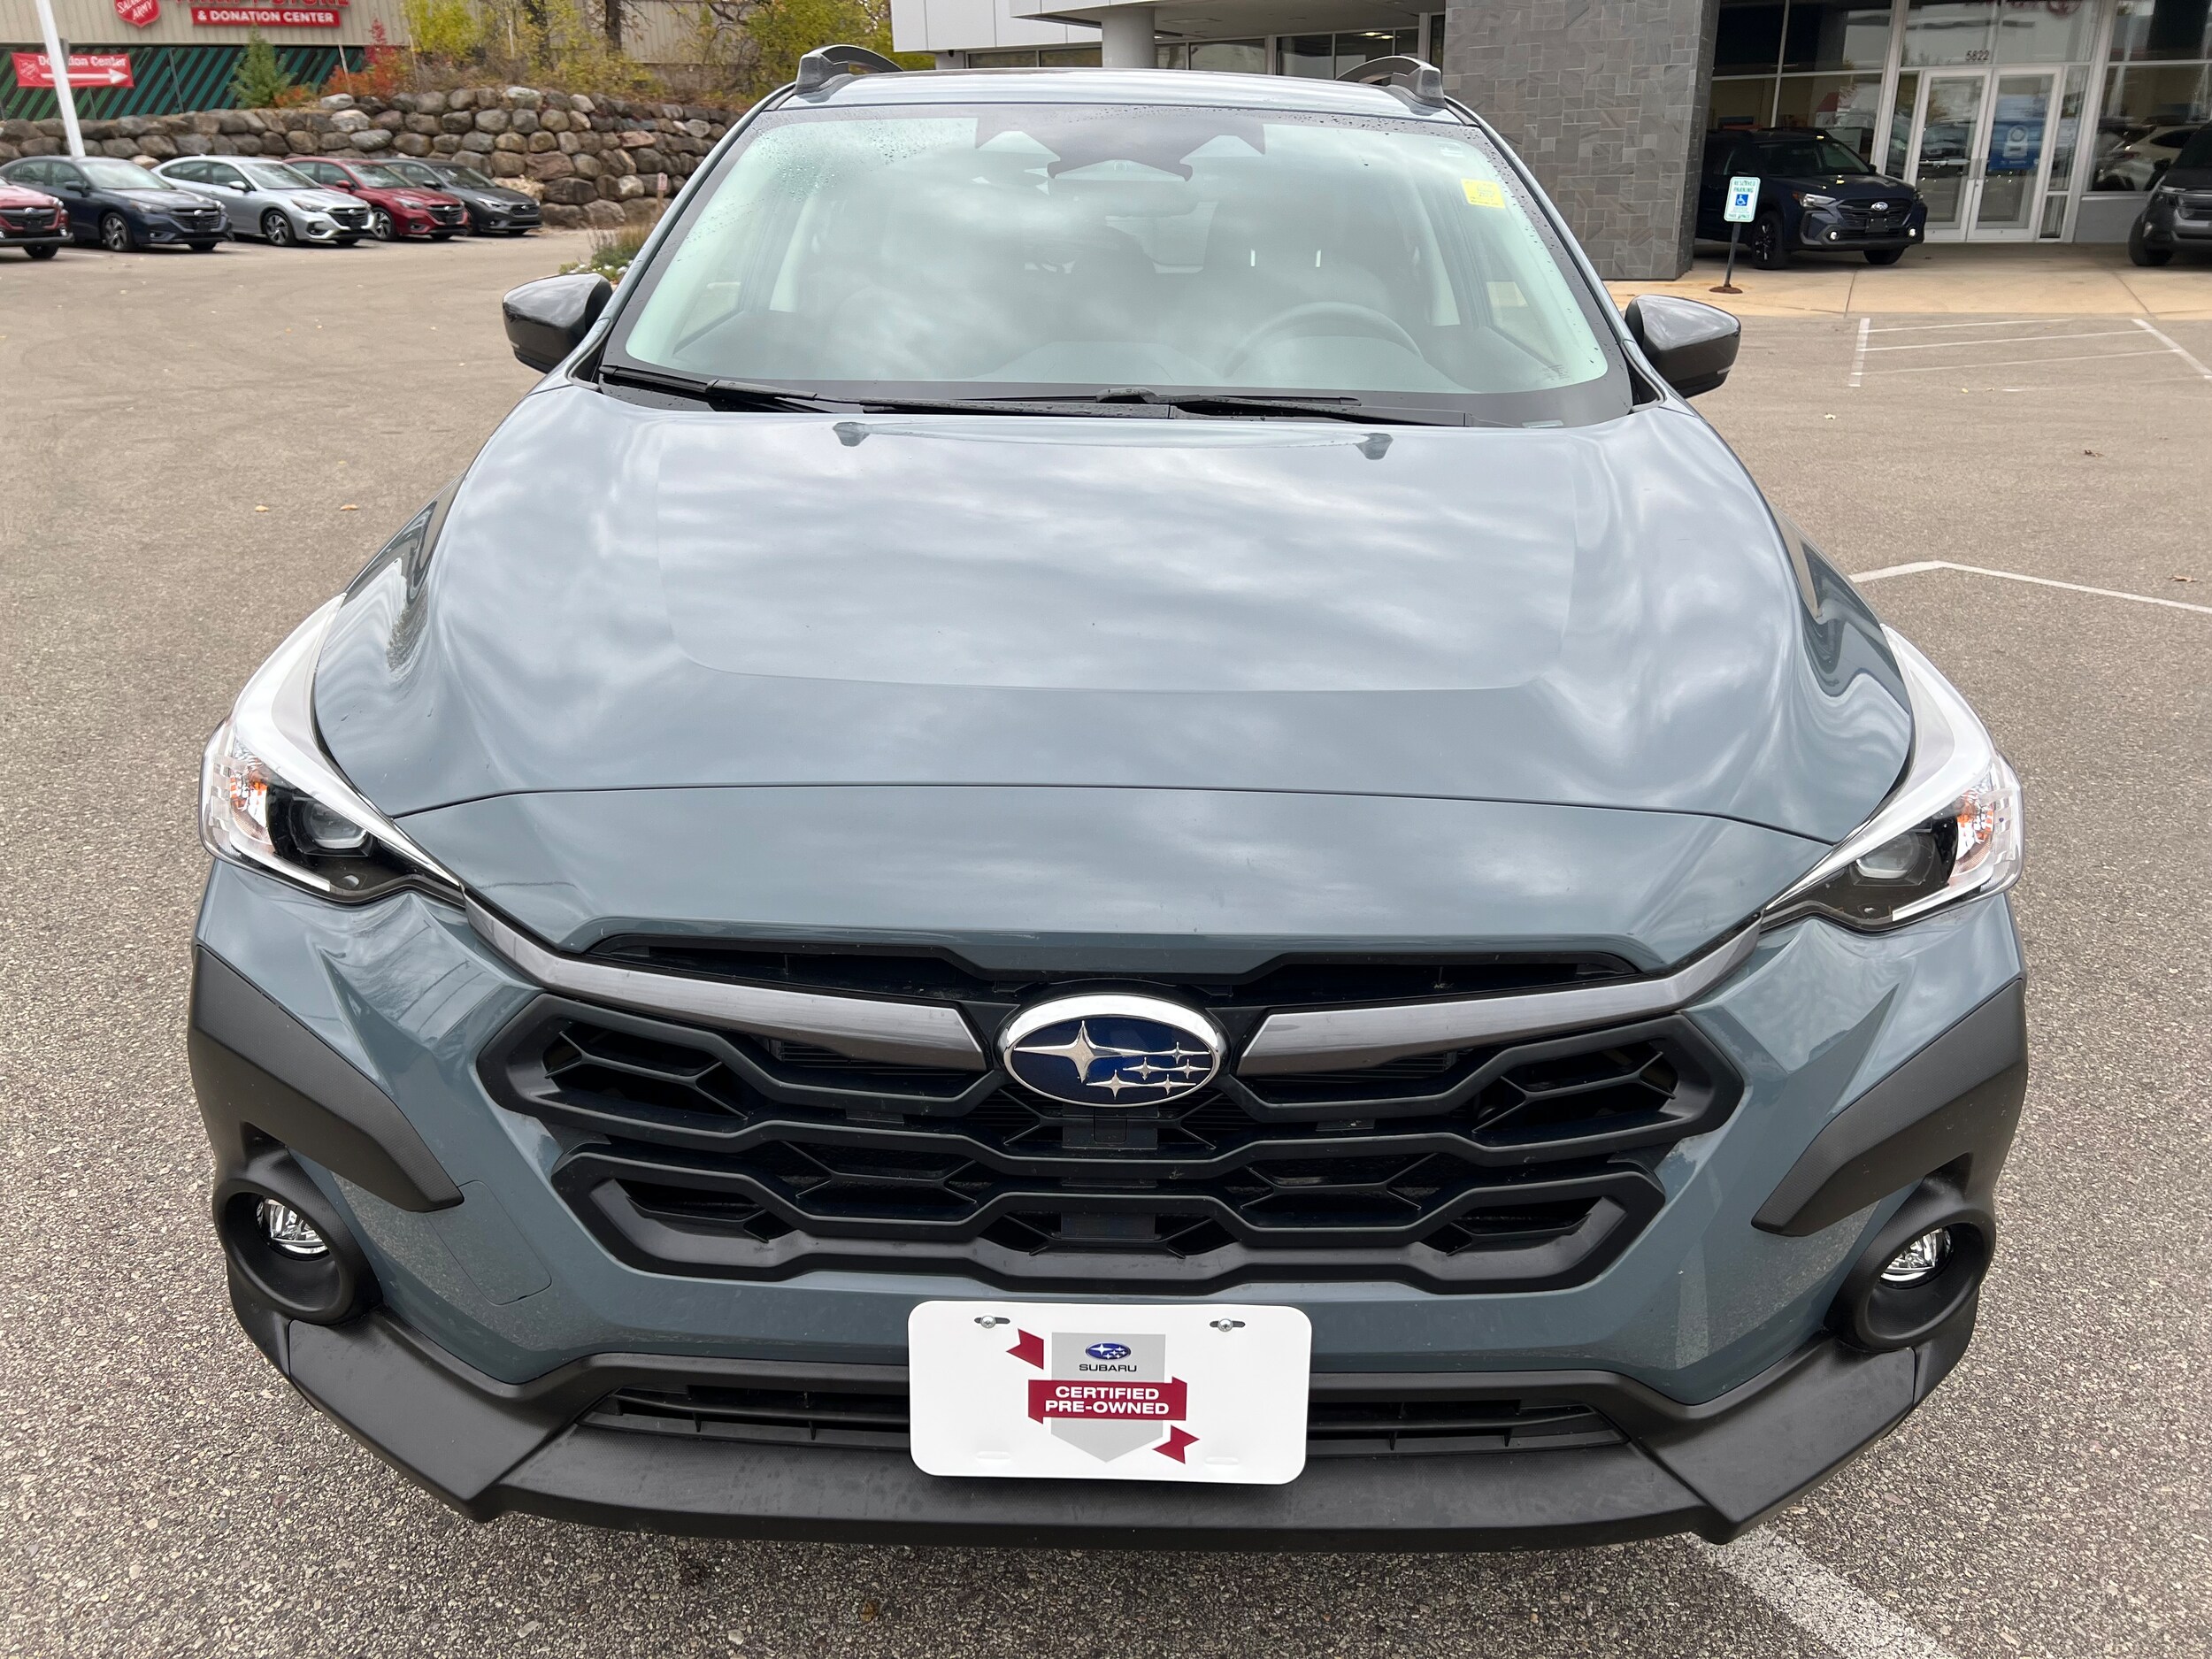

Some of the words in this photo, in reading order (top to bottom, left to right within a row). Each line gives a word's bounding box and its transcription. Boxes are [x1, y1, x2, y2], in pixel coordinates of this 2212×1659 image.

[133, 0, 153, 20] ARMY
[197, 10, 208, 21] &
[210, 11, 281, 22] DONATION
[282, 12, 334, 23] CENTER
[37, 55, 89, 66] Dotion
[90, 56, 127, 67] Center
[1079, 1363, 1137, 1372] SUBARU
[1055, 1386, 1159, 1400] CERTIFIED
[1045, 1400, 1169, 1415] PRE-OWNED
